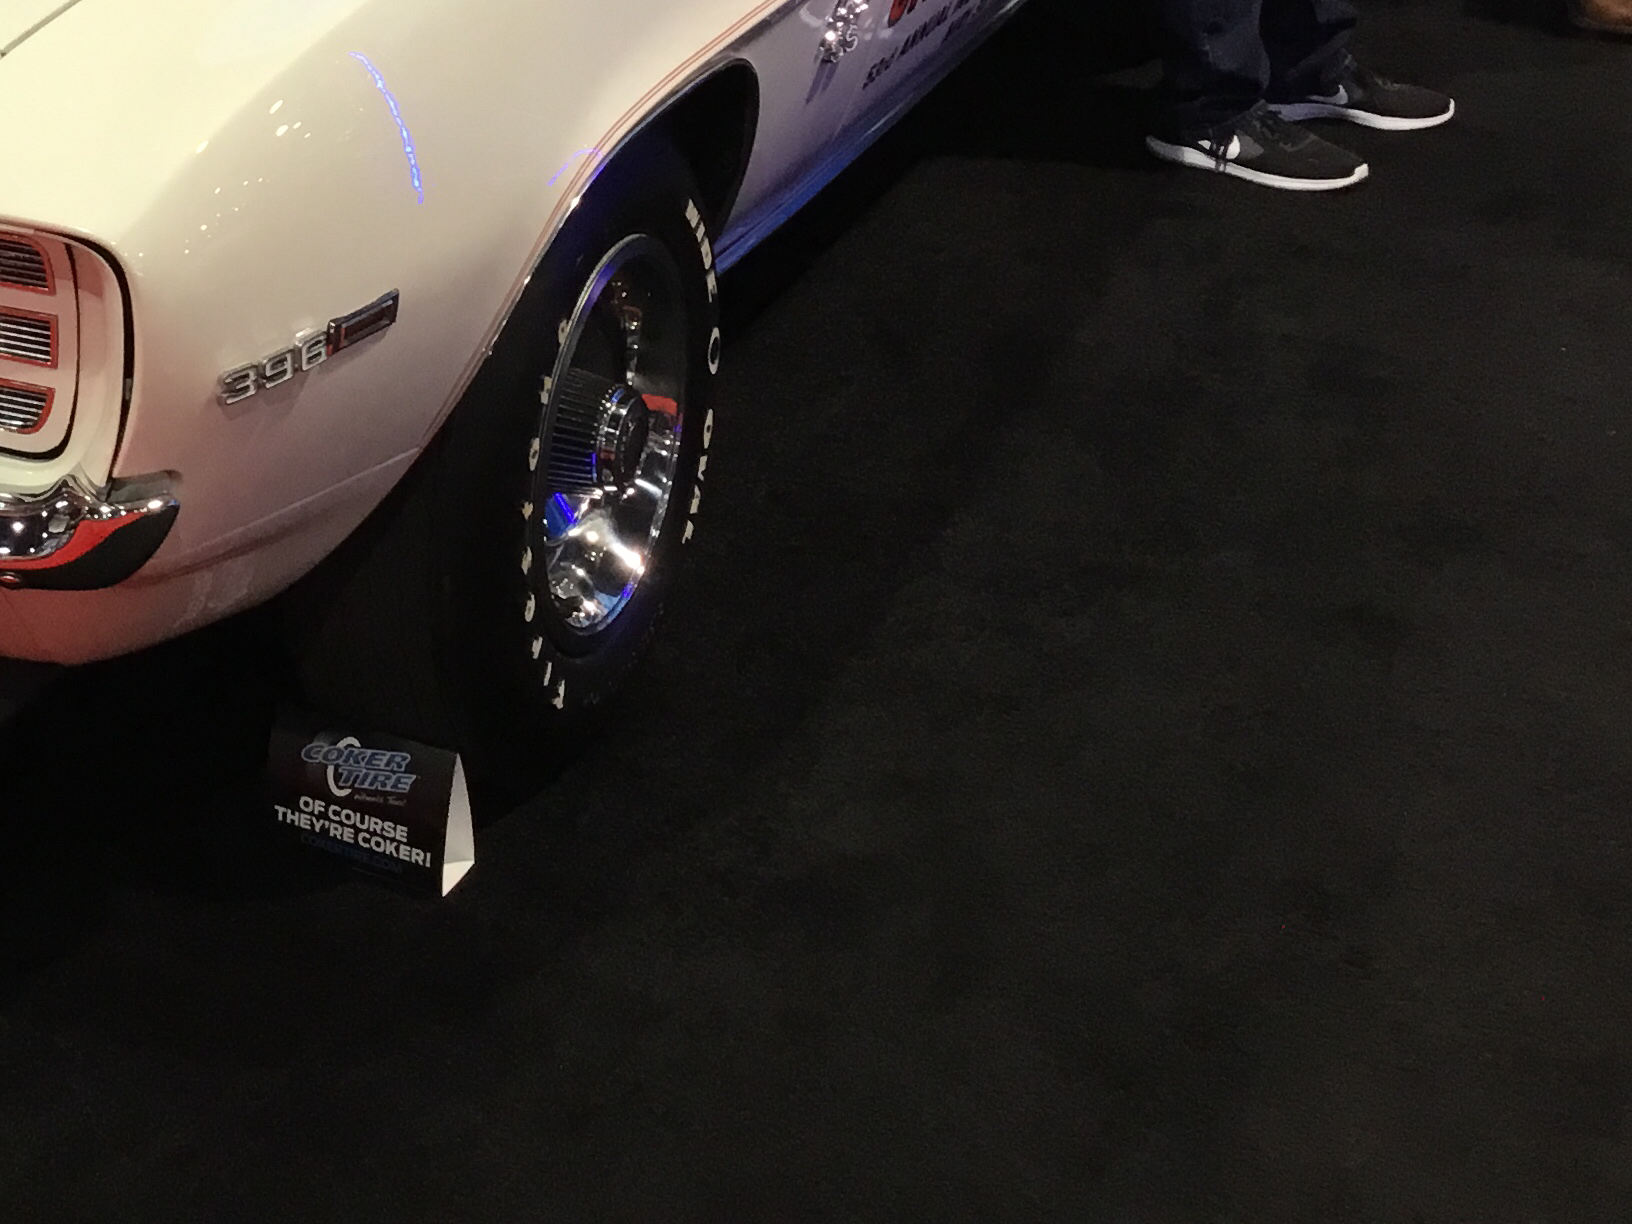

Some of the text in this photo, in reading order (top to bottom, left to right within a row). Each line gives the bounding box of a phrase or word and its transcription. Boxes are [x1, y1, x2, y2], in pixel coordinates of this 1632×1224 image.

[217, 327, 329, 405] 396
[301, 741, 412, 772] COKER
[338, 766, 417, 794] TIRE
[274, 804, 432, 868] THEY'RE COKER!
[299, 795, 408, 843] OF COURSE
